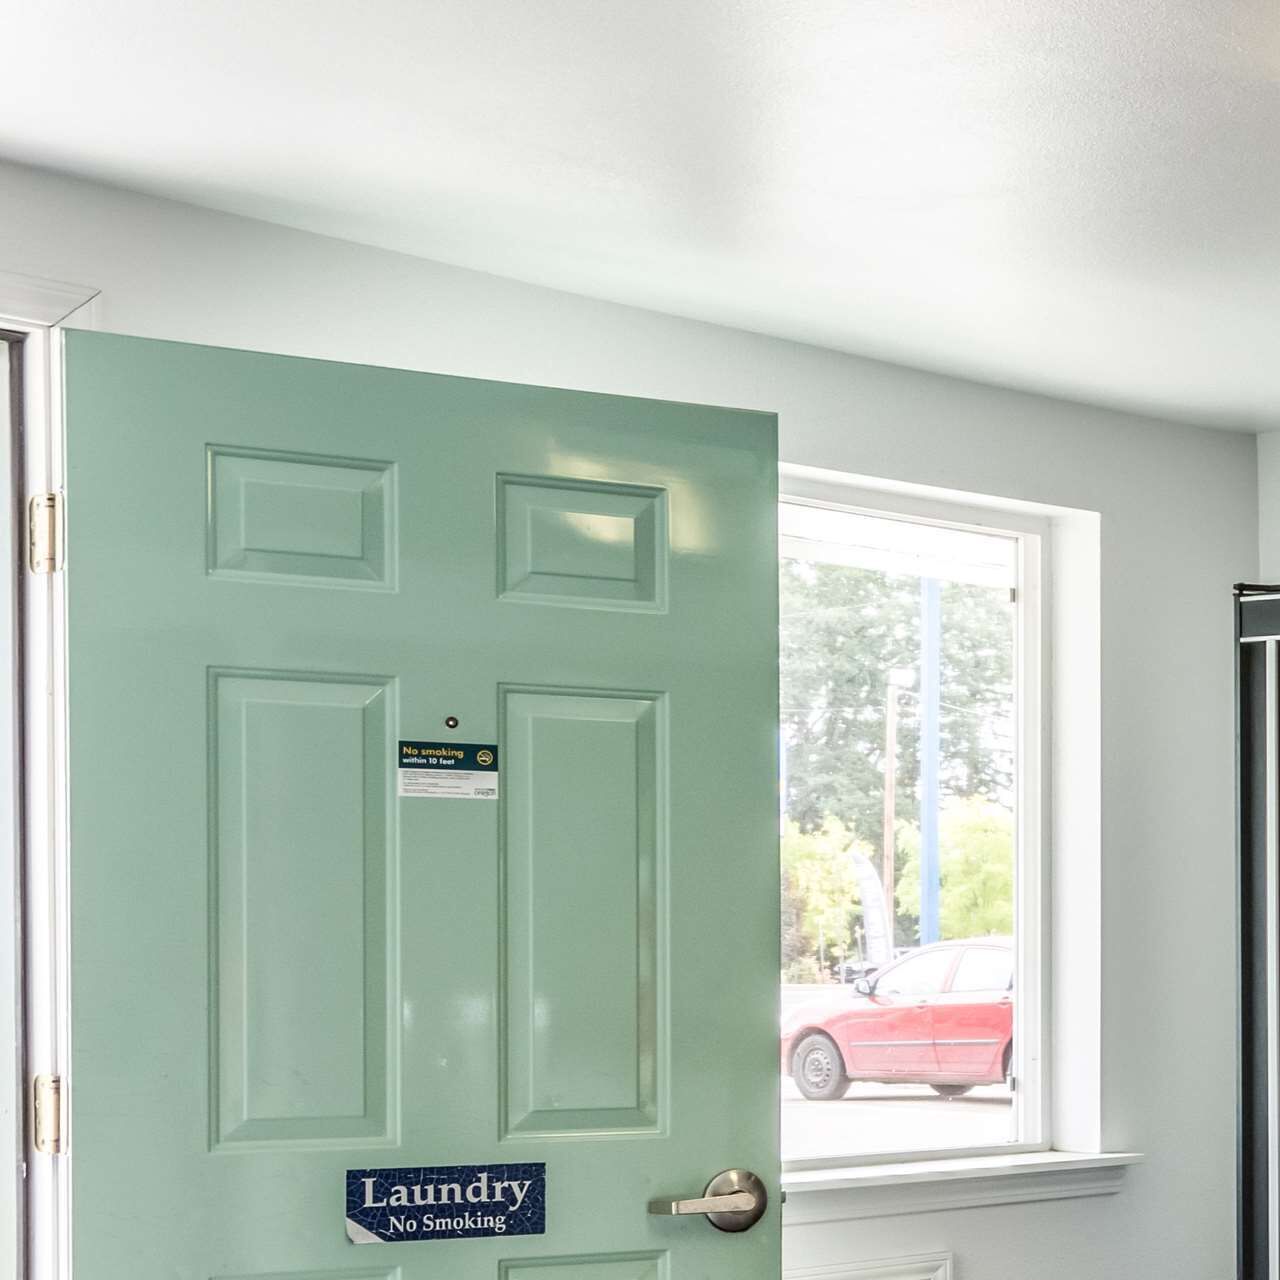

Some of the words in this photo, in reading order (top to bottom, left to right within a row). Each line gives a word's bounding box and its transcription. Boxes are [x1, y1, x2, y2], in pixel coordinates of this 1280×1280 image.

[402, 746, 419, 756] No
[421, 748, 465, 759] smoking
[402, 757, 427, 765] within
[429, 757, 438, 765] 10
[361, 1172, 533, 1212] Laundry
[388, 1216, 417, 1233] No
[422, 1212, 507, 1232] Smoking
